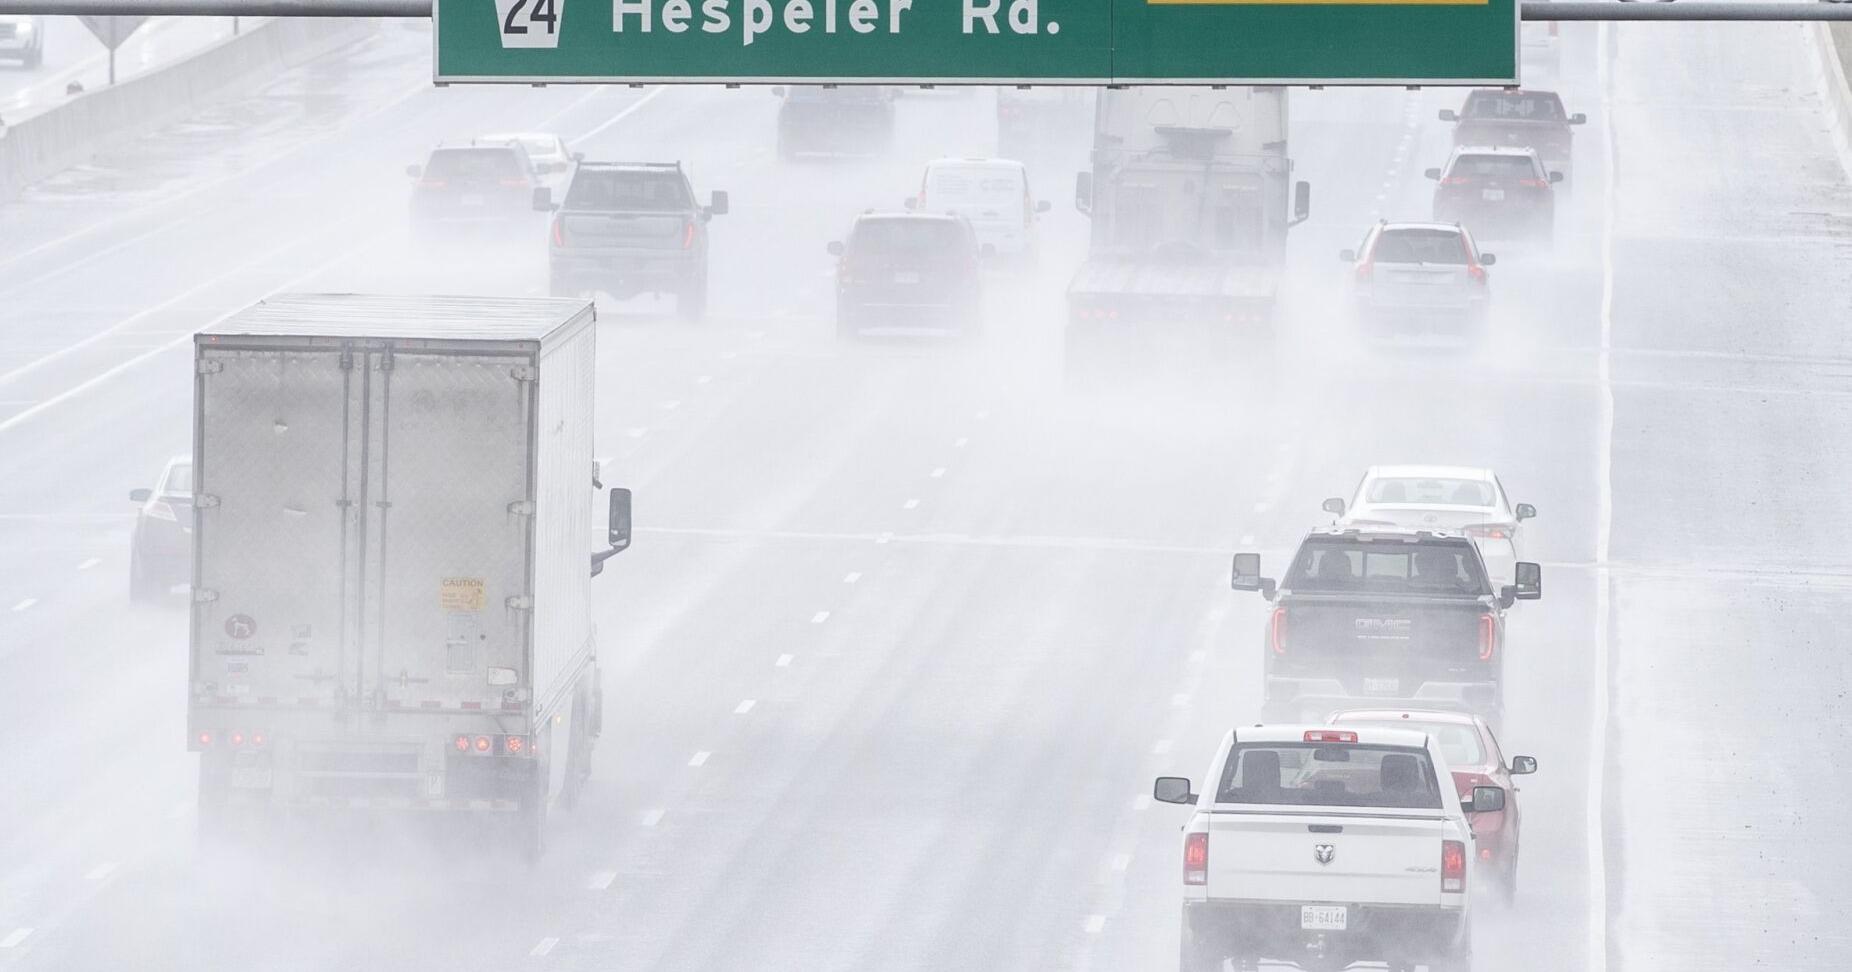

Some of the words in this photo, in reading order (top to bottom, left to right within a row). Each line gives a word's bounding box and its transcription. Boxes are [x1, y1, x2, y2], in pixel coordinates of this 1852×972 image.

[503, 0, 557, 35] 24
[612, 0, 913, 47] Hespeler
[962, 0, 1060, 35] Rd.
[442, 578, 484, 587] CAUTION
